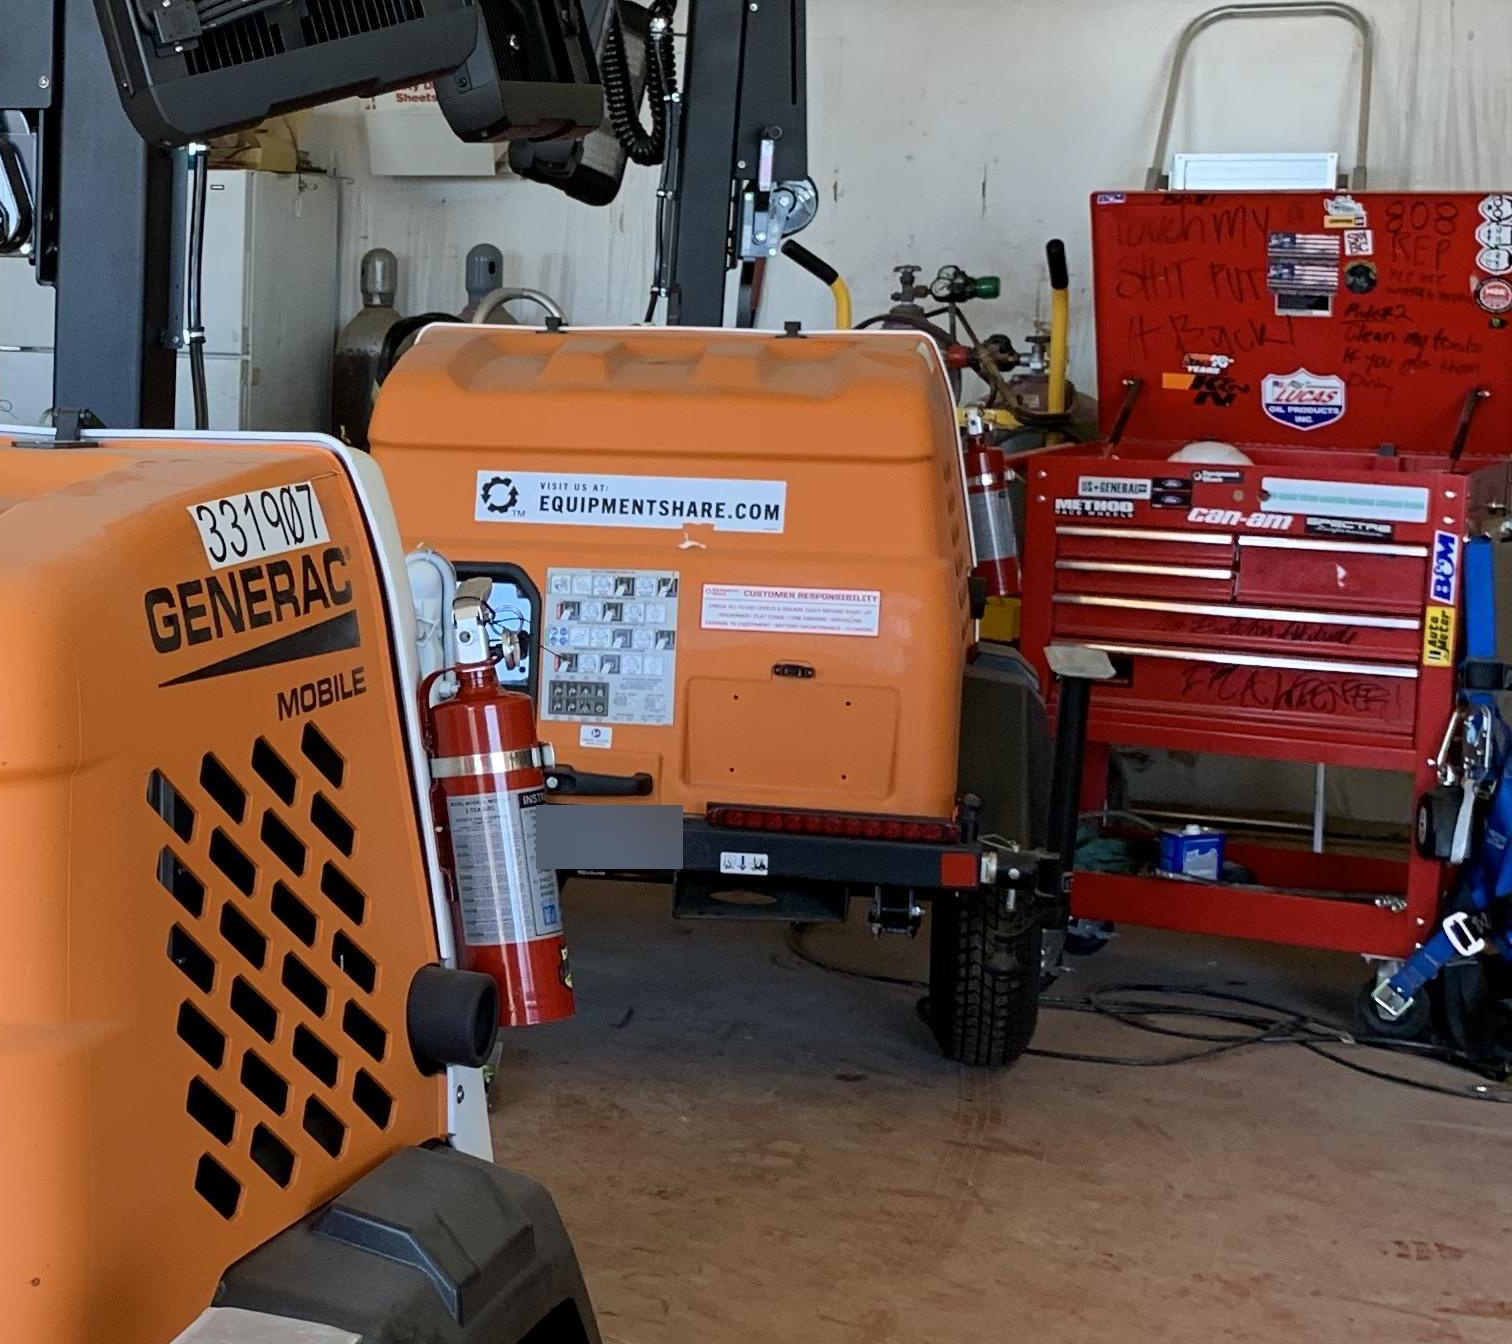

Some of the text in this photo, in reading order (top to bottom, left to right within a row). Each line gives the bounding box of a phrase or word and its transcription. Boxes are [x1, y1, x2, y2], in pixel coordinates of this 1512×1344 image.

[1268, 405, 1341, 415] OIL PRODUCTS
[1273, 389, 1338, 404] LUCAS
[540, 481, 609, 493] VISIT US AT:
[539, 495, 780, 522] EQUIPMENTSHARE.COM
[1055, 498, 1134, 513] METHOD
[1187, 507, 1294, 530] can-am
[196, 484, 319, 562] 331907
[144, 547, 354, 654] GENERAC
[1428, 616, 1439, 648] Auto
[1437, 610, 1450, 653] Meter
[277, 666, 367, 721] MOBILE
